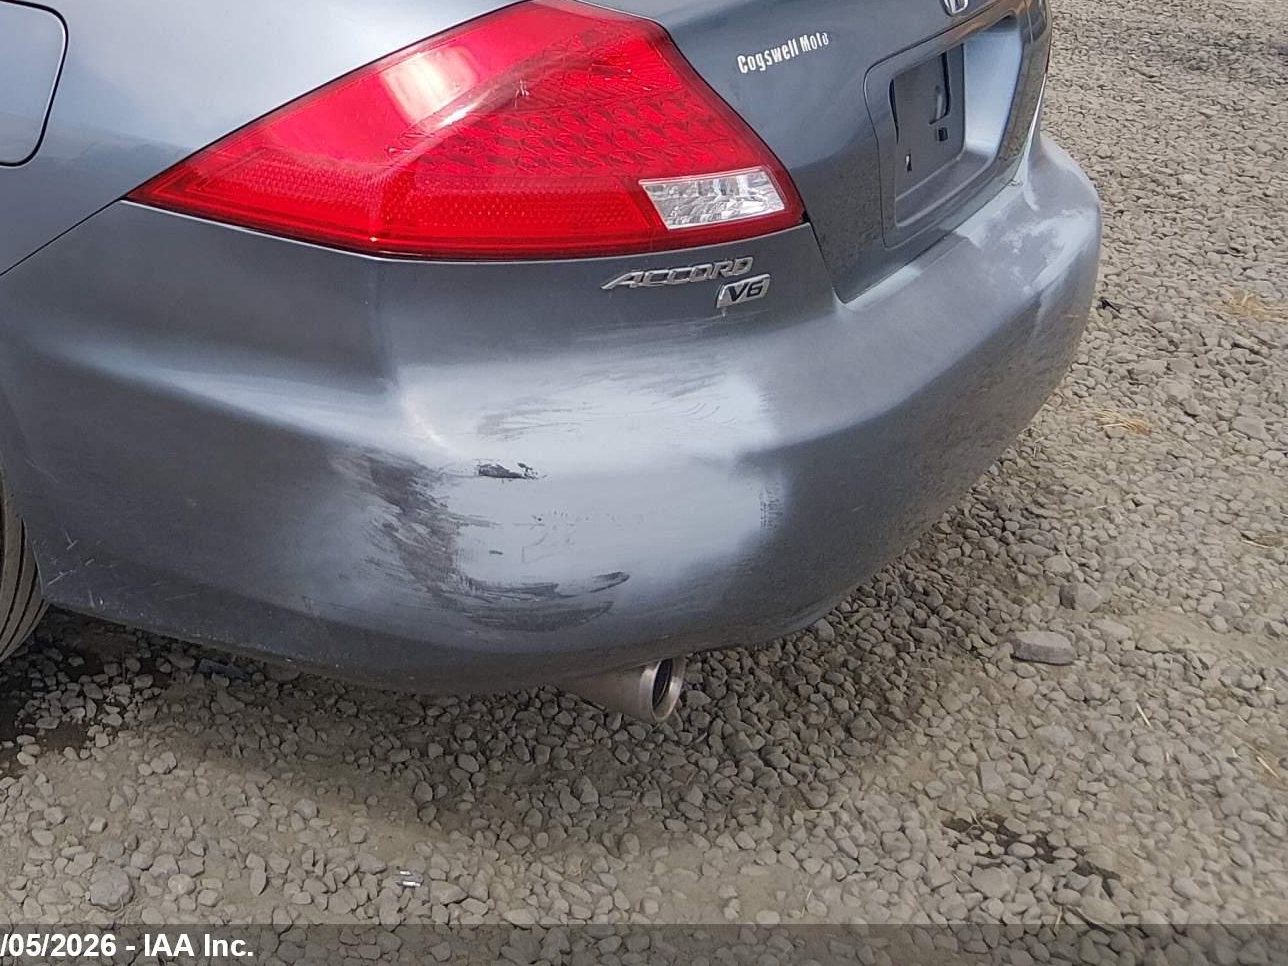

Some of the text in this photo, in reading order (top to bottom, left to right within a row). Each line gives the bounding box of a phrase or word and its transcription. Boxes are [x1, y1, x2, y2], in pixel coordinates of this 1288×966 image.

[737, 38, 799, 74] Cogswell
[601, 256, 754, 290] ACCORD
[725, 279, 765, 303] V6
